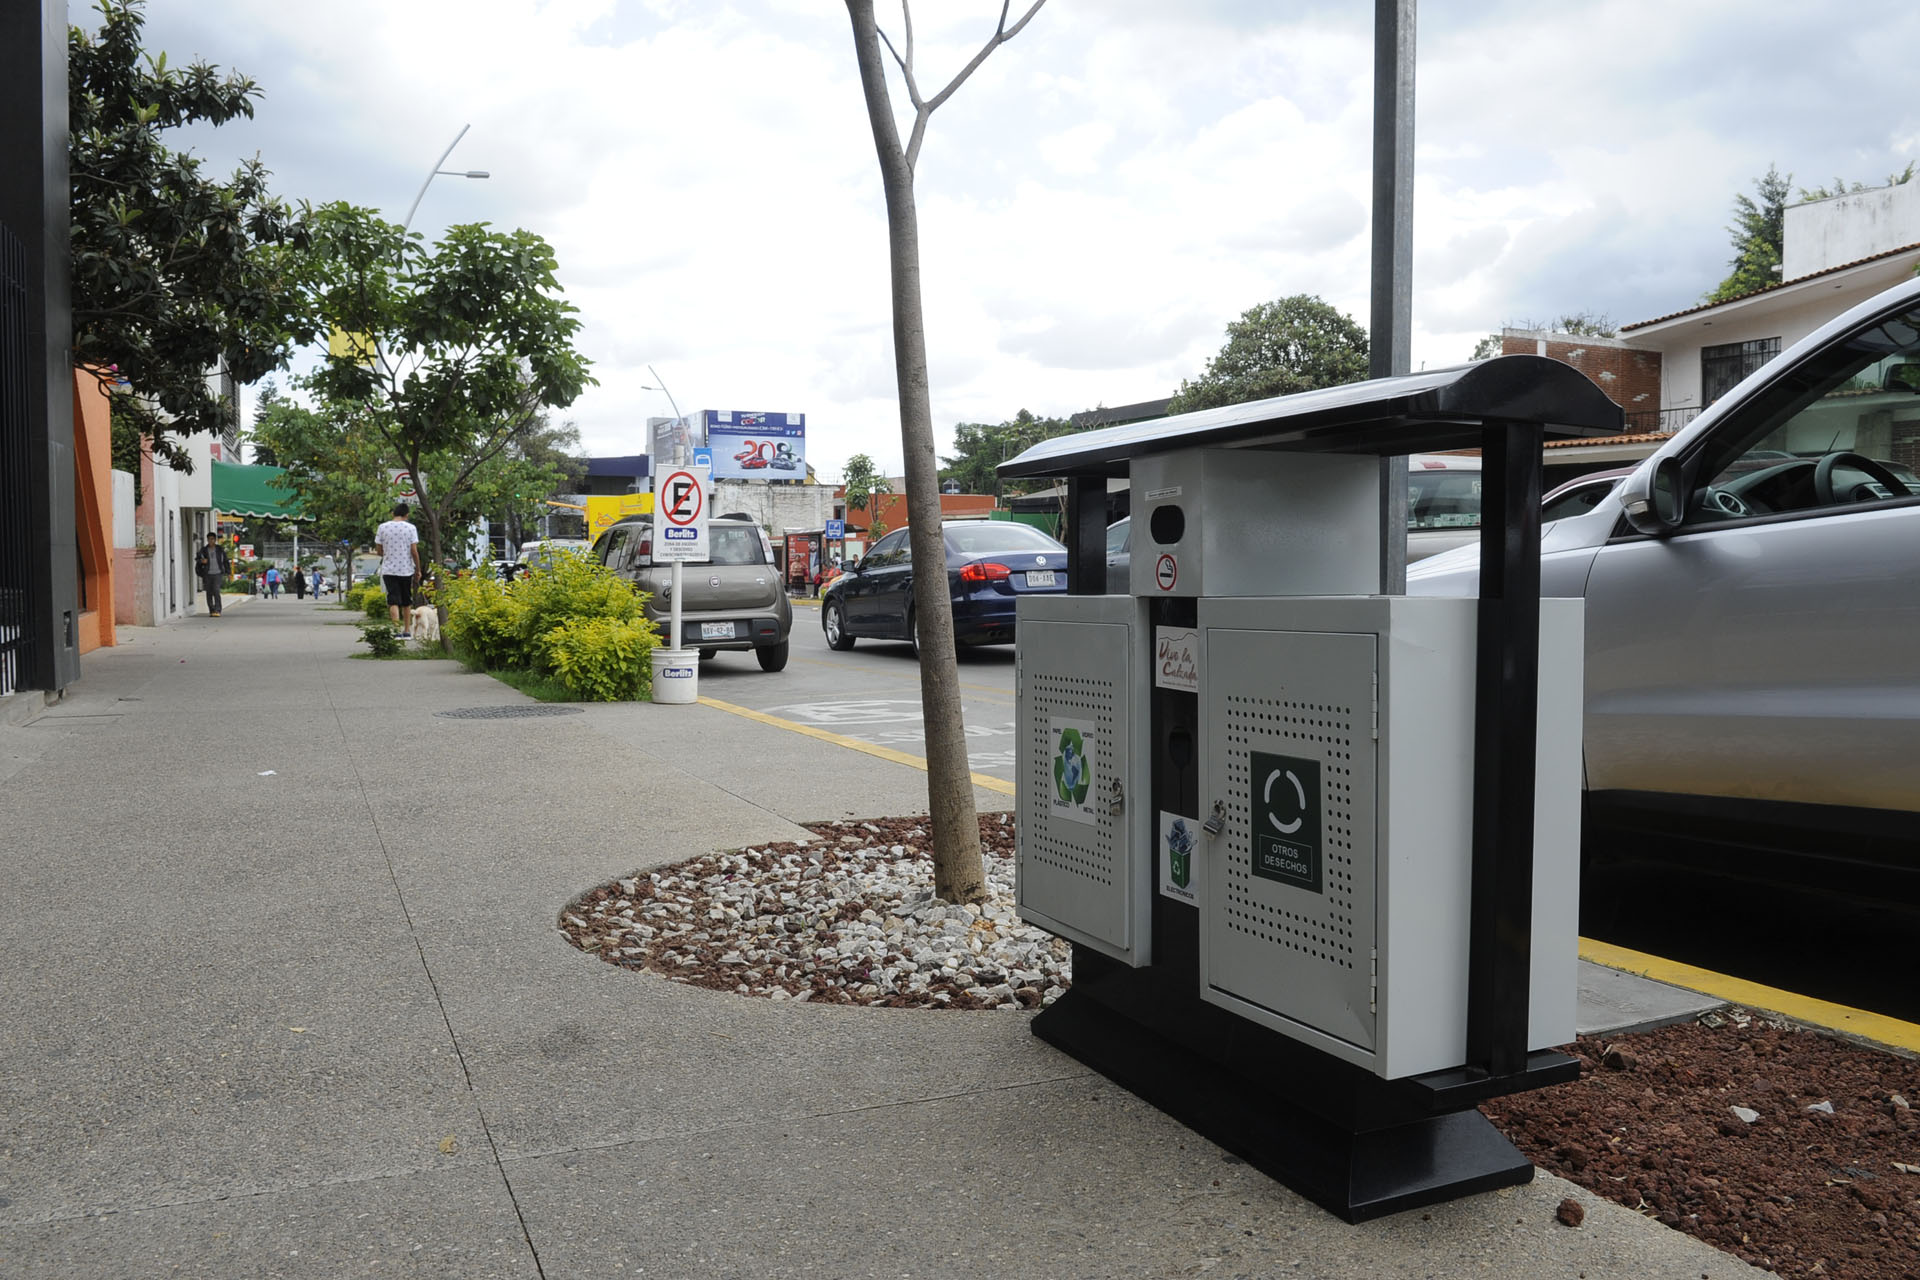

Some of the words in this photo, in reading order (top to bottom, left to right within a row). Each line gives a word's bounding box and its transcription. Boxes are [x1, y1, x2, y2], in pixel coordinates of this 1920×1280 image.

[668, 529, 695, 538] Berlitz
[665, 669, 692, 678] Berlitz
[1272, 843, 1299, 859] OTROS
[1264, 854, 1308, 874] DESECHOS
